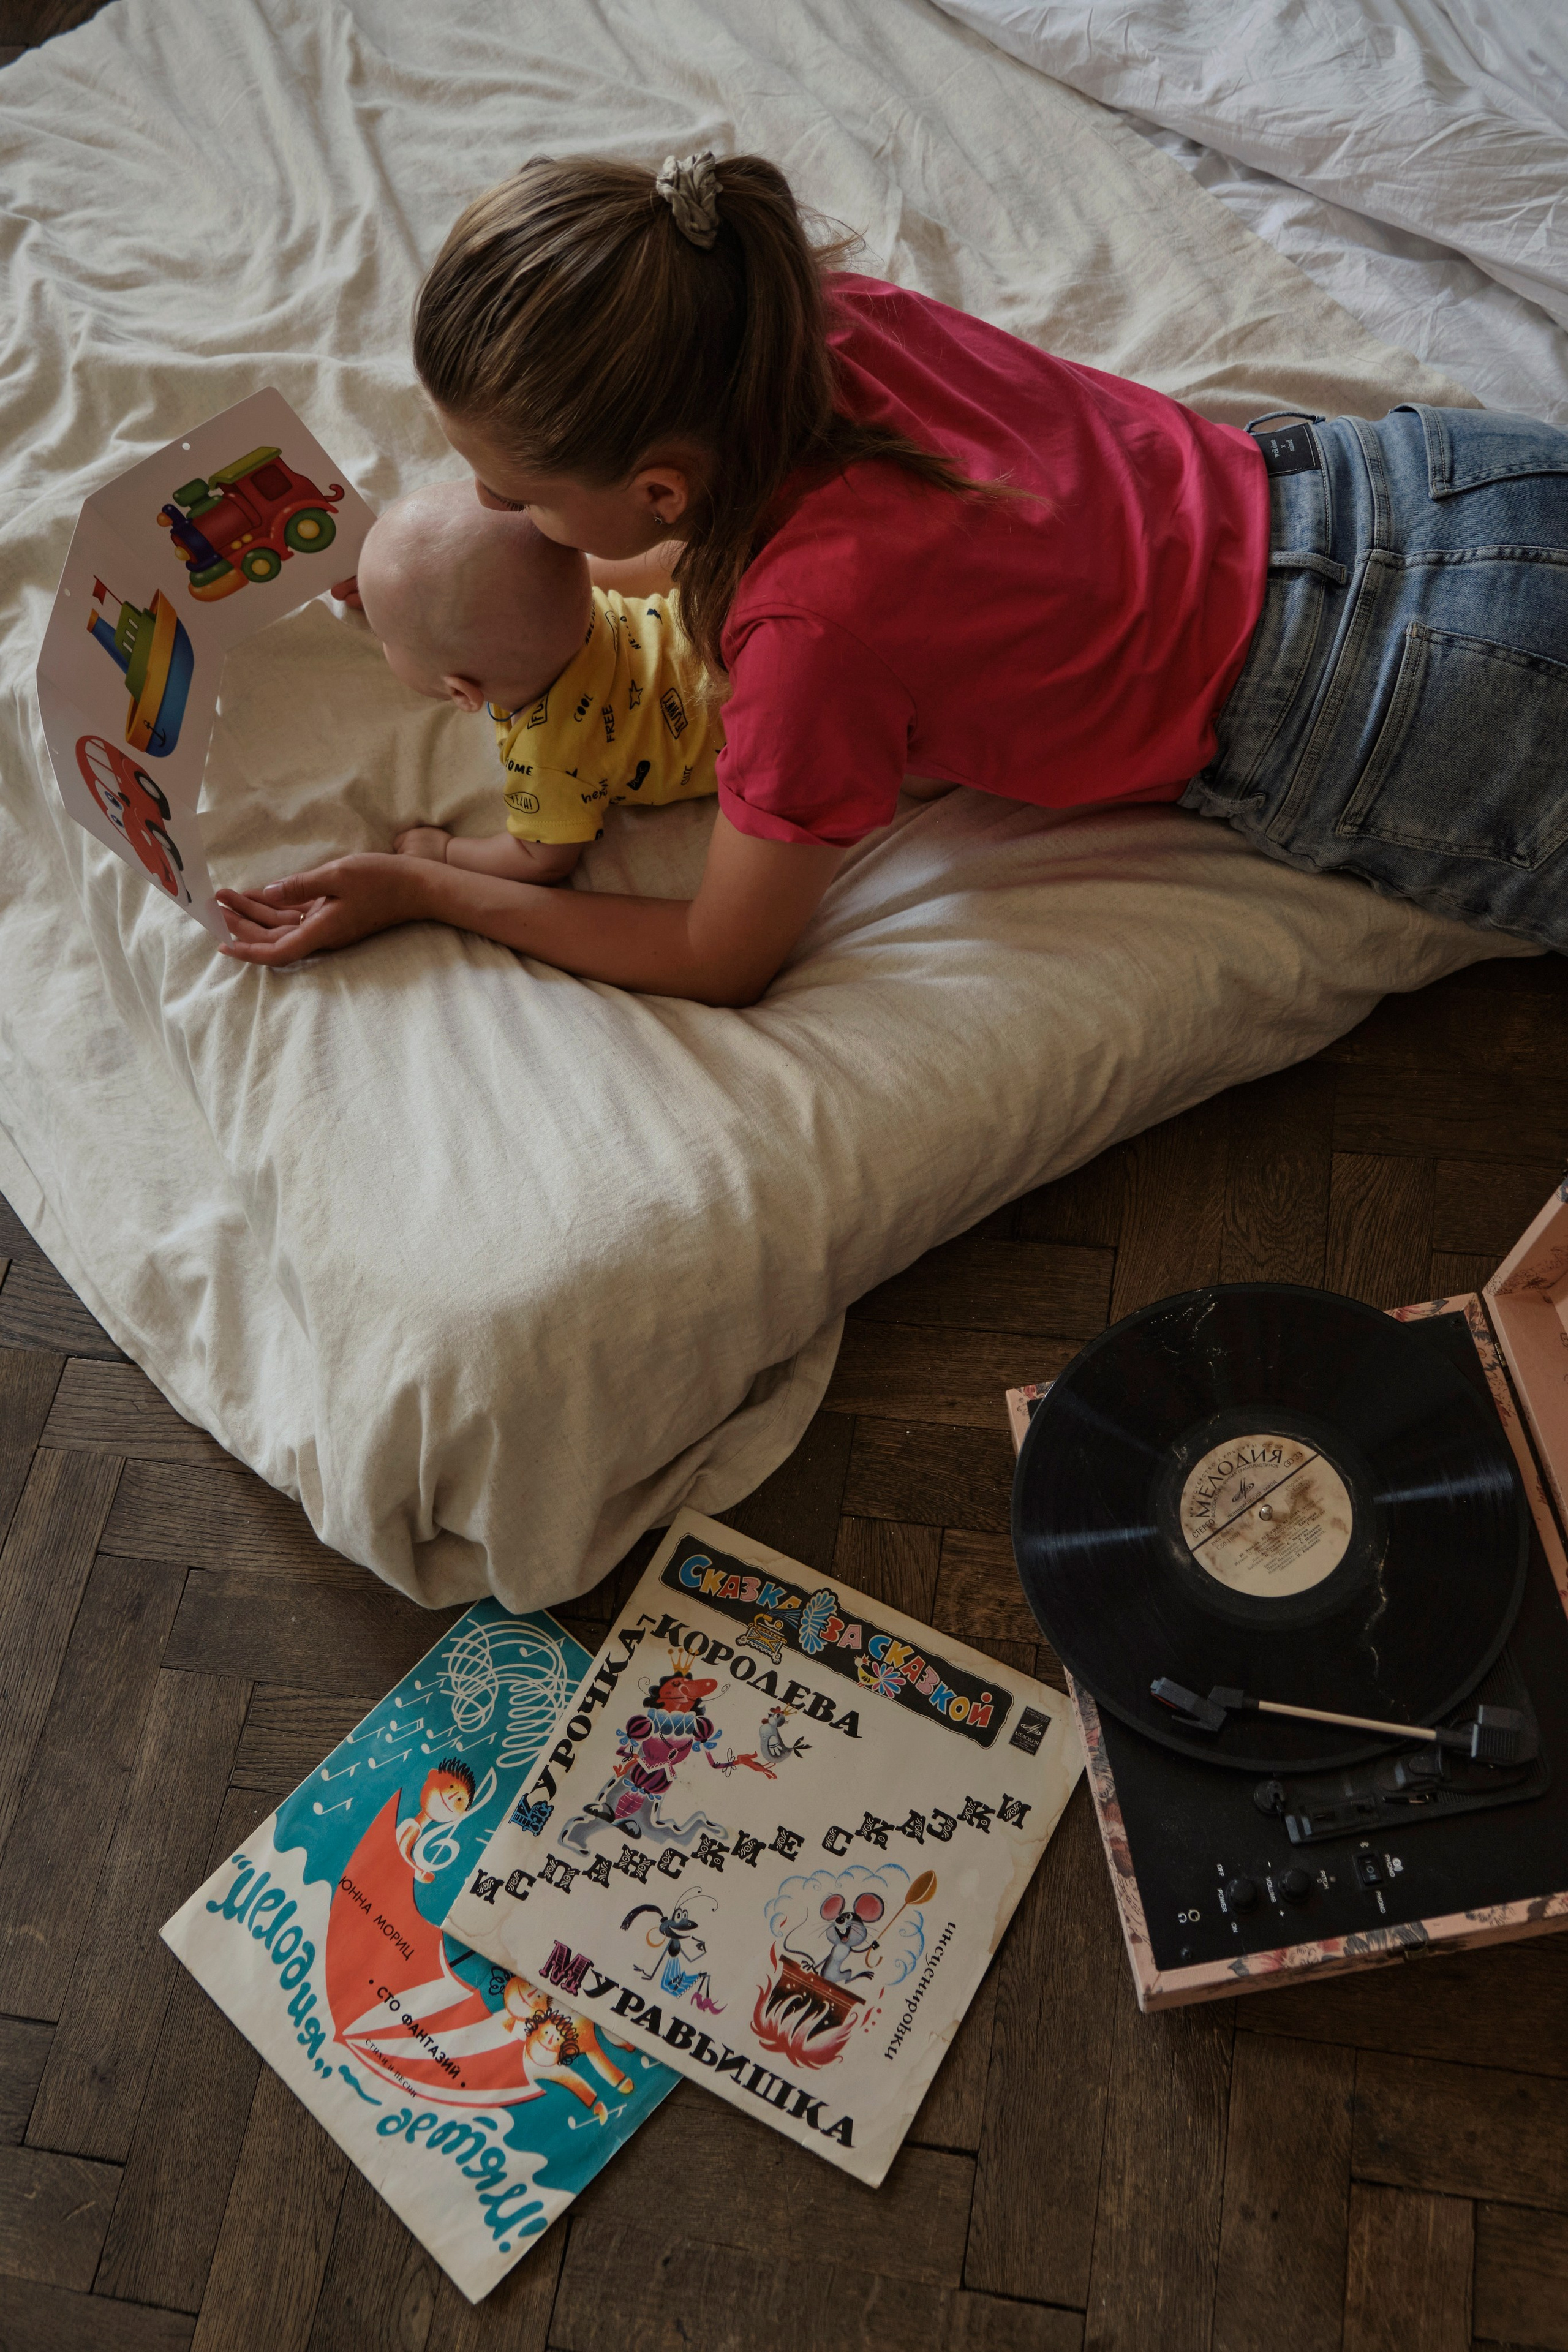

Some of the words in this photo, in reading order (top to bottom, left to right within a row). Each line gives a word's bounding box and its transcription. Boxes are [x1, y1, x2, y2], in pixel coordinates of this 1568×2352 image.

[574, 693, 593, 722] COOL
[601, 704, 615, 742] FREE
[663, 695, 682, 732] FUNNY
[510, 794, 532, 810] YEAH!
[1192, 1519, 1215, 1538] СТЕРЕО
[1293, 1451, 1303, 1460] 33
[1195, 1449, 1282, 1517] МЕЛОДИЯ
[1263, 1480, 1277, 1493] ЗАВОД
[651, 1613, 862, 1738] КОРОЛЕВА
[817, 1616, 862, 1649] ЗА
[868, 1634, 995, 1728] СКАЗКОЙ
[1015, 1731, 1039, 1745] МЕЛОДИЯ
[470, 1825, 805, 1905] ИСПАНСКИЕ
[822, 1793, 1033, 1857] СКАЗКИ
[1385, 1853, 1395, 1877] PHONO
[1265, 1876, 1276, 1903] VOLUME
[1319, 1869, 1329, 1889] PITCH
[338, 1875, 372, 1914] ЮННА
[373, 1915, 414, 1961] МОРИЦ
[1217, 1888, 1227, 1913] POWER
[1375, 1890, 1386, 1913] PHONO
[1231, 1922, 1238, 1933] ON
[883, 1921, 957, 2061] инсценировки
[377, 1986, 401, 2013] СТО
[400, 2013, 461, 2079] ФАНТАЗИЙ
[538, 1939, 856, 2149] МУРАВЬИШКА
[365, 2038, 388, 2065] СТИХИ
[394, 2071, 417, 2098] ПЕСНИ
